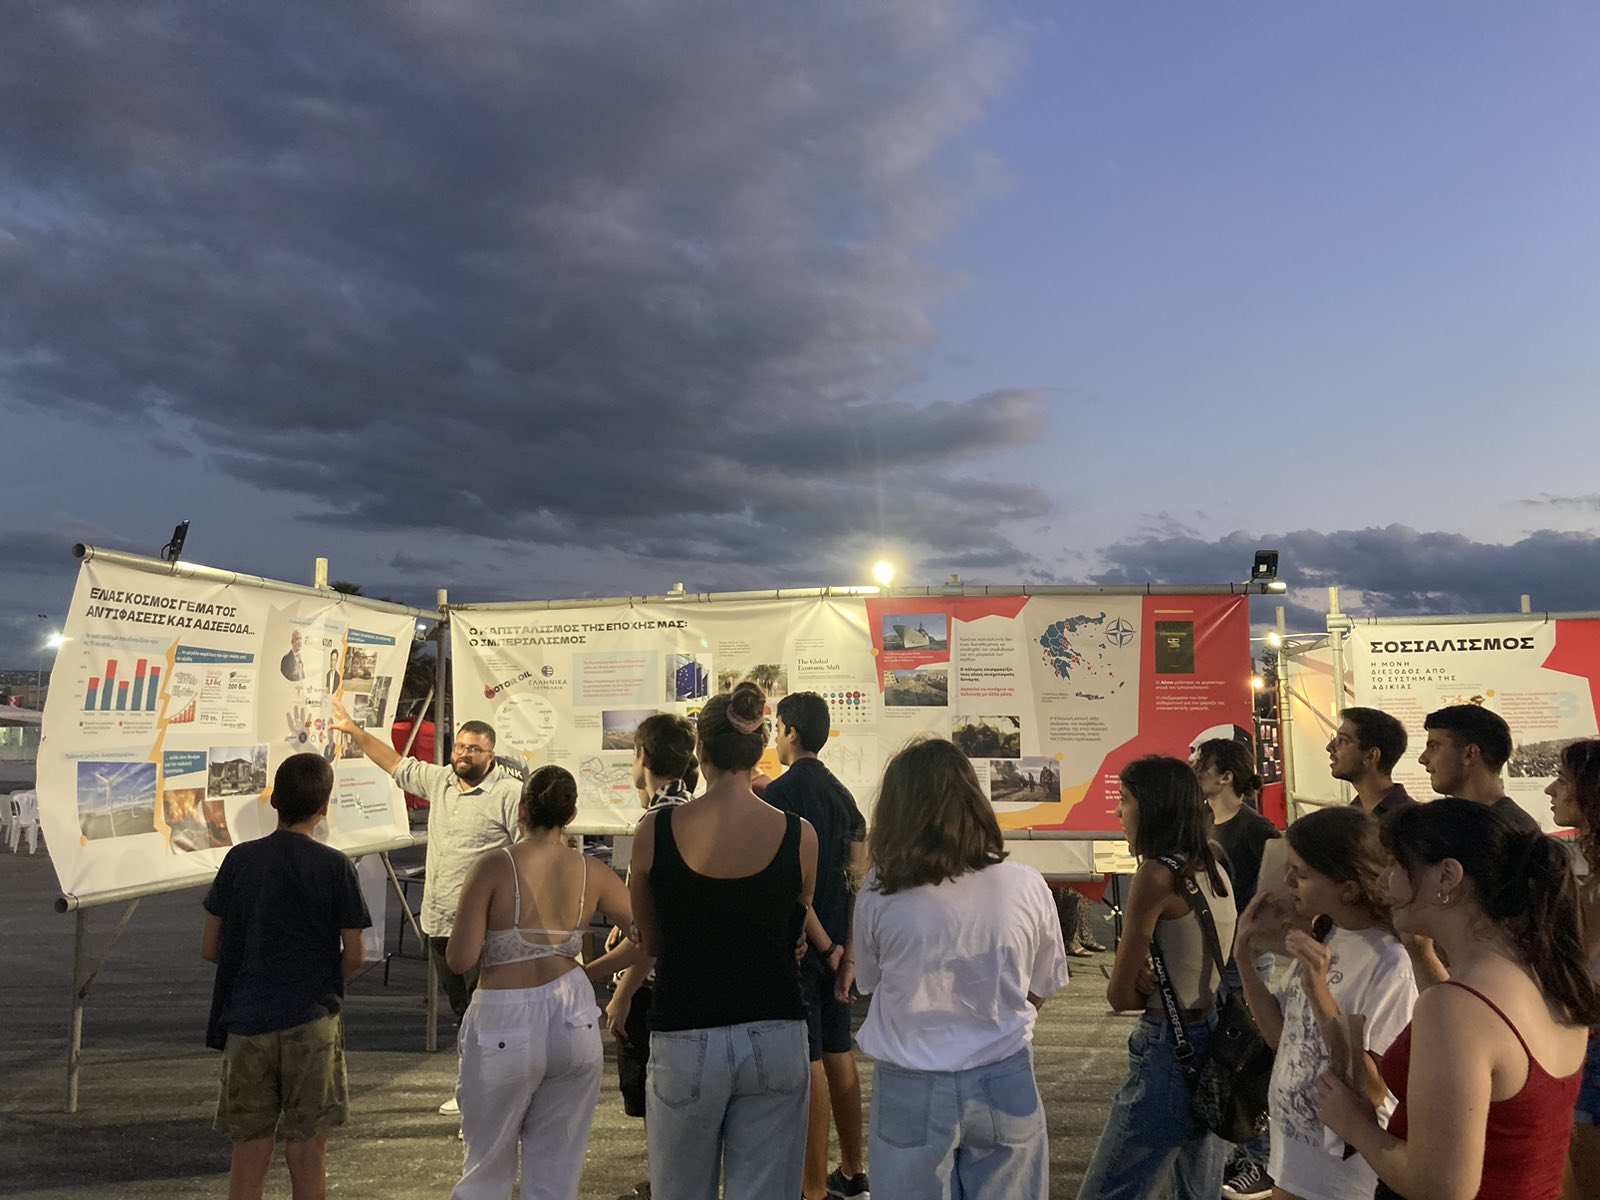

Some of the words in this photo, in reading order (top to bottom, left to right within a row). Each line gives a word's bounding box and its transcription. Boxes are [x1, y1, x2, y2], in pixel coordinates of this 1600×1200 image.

[90, 587, 125, 602] ΕΝΑΣ
[125, 591, 178, 610] ΚΟΣΜΟΣ
[178, 599, 237, 618] ΓΕΜΑΤΟΣ
[86, 605, 167, 625] ΑΝΤΙΦΑΣΕΙΣ
[166, 615, 192, 629] ΚΑΙ
[480, 624, 580, 636] ΚΑΠΙΤΑΛΙΣΜΟΣ
[581, 623, 605, 632] ΤΗΣ
[606, 621, 655, 631] ΕΠΟΧΗΣ
[657, 620, 688, 629] ΜΑΣ:
[480, 636, 586, 647] ΙΜΠΕΡΙΑΛΙΣΜΟΣ
[1370, 637, 1534, 653] ΣΟΣΙΑΛΙΣΜΟΣ
[487, 678, 518, 696] MOTOR
[518, 671, 533, 681] OIL
[1155, 956, 1166, 986] KARL
